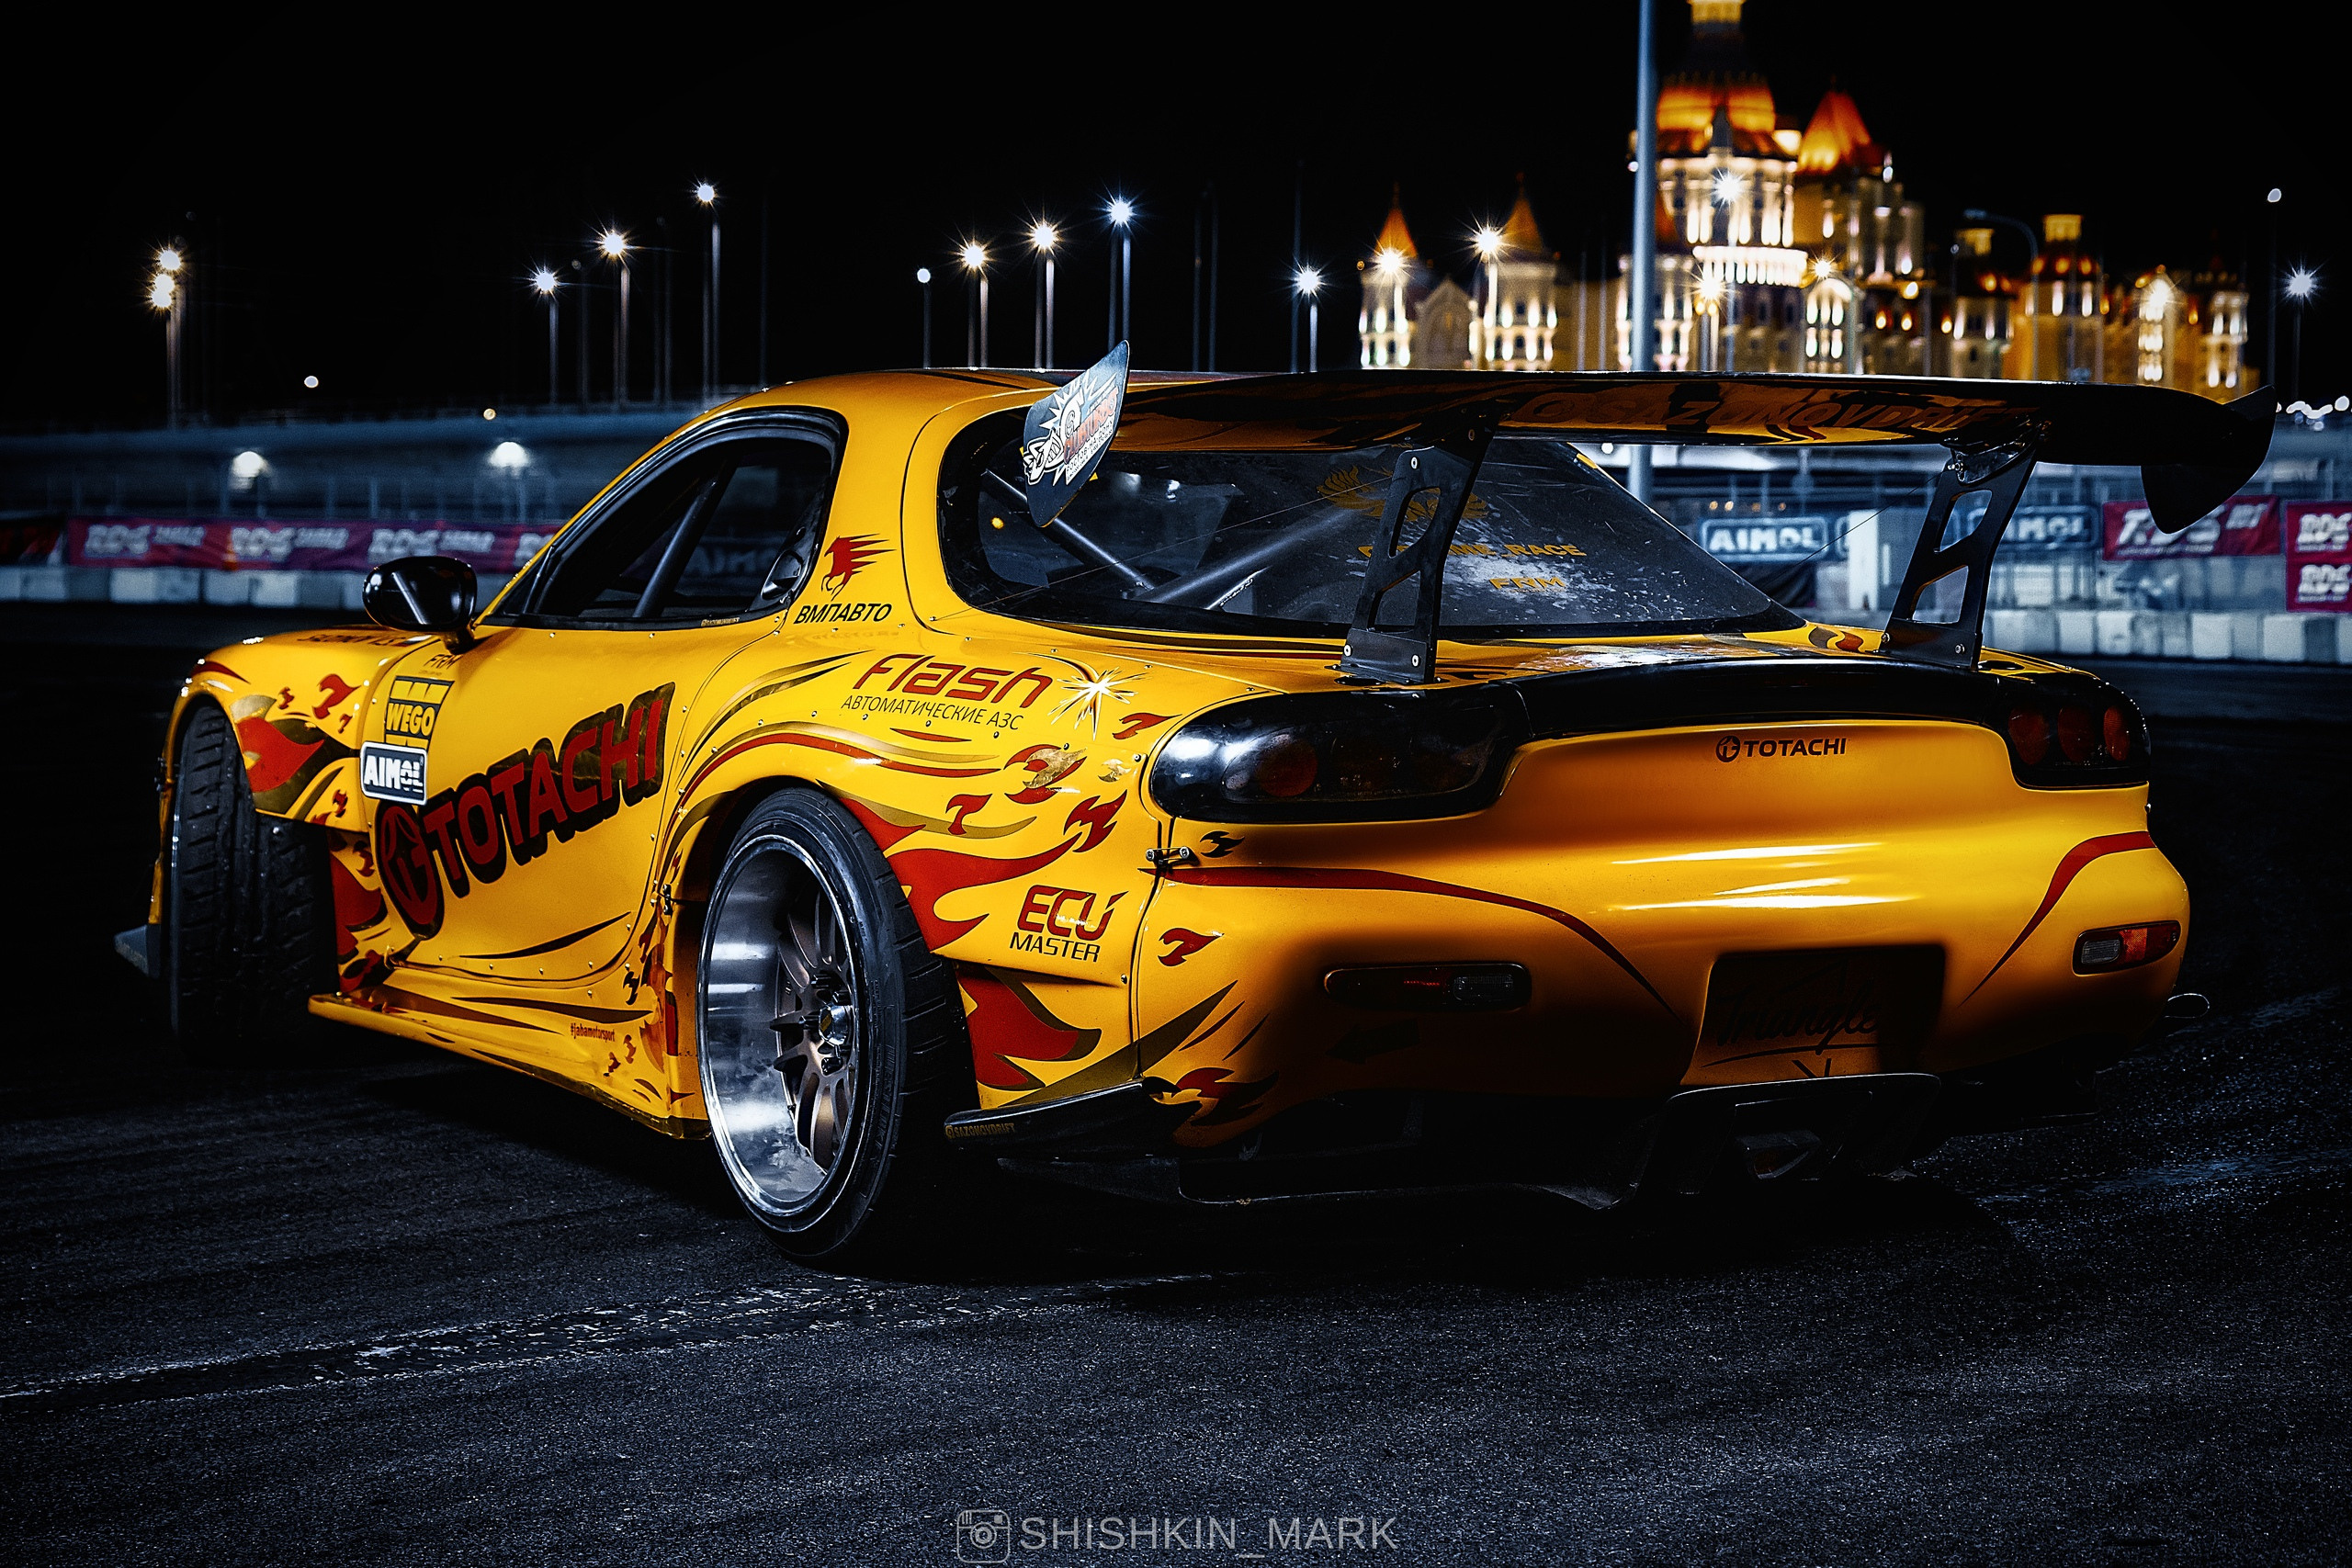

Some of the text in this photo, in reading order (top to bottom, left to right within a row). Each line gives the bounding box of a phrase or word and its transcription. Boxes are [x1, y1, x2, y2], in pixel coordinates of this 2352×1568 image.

[1708, 526, 1818, 552] AIMOL
[793, 603, 892, 625] ВМПАВТО
[387, 702, 436, 736] WEGO
[841, 695, 1024, 731] АВТОМАТИЧЕСКИЕ АЗС
[1743, 738, 1847, 757] TOTACHI
[363, 755, 424, 794] AIMOL
[423, 698, 663, 882] TOTACHI
[1017, 885, 1128, 941] ECU
[1010, 931, 1101, 963] MASTER
[570, 1022, 616, 1043] #jabamotorsport
